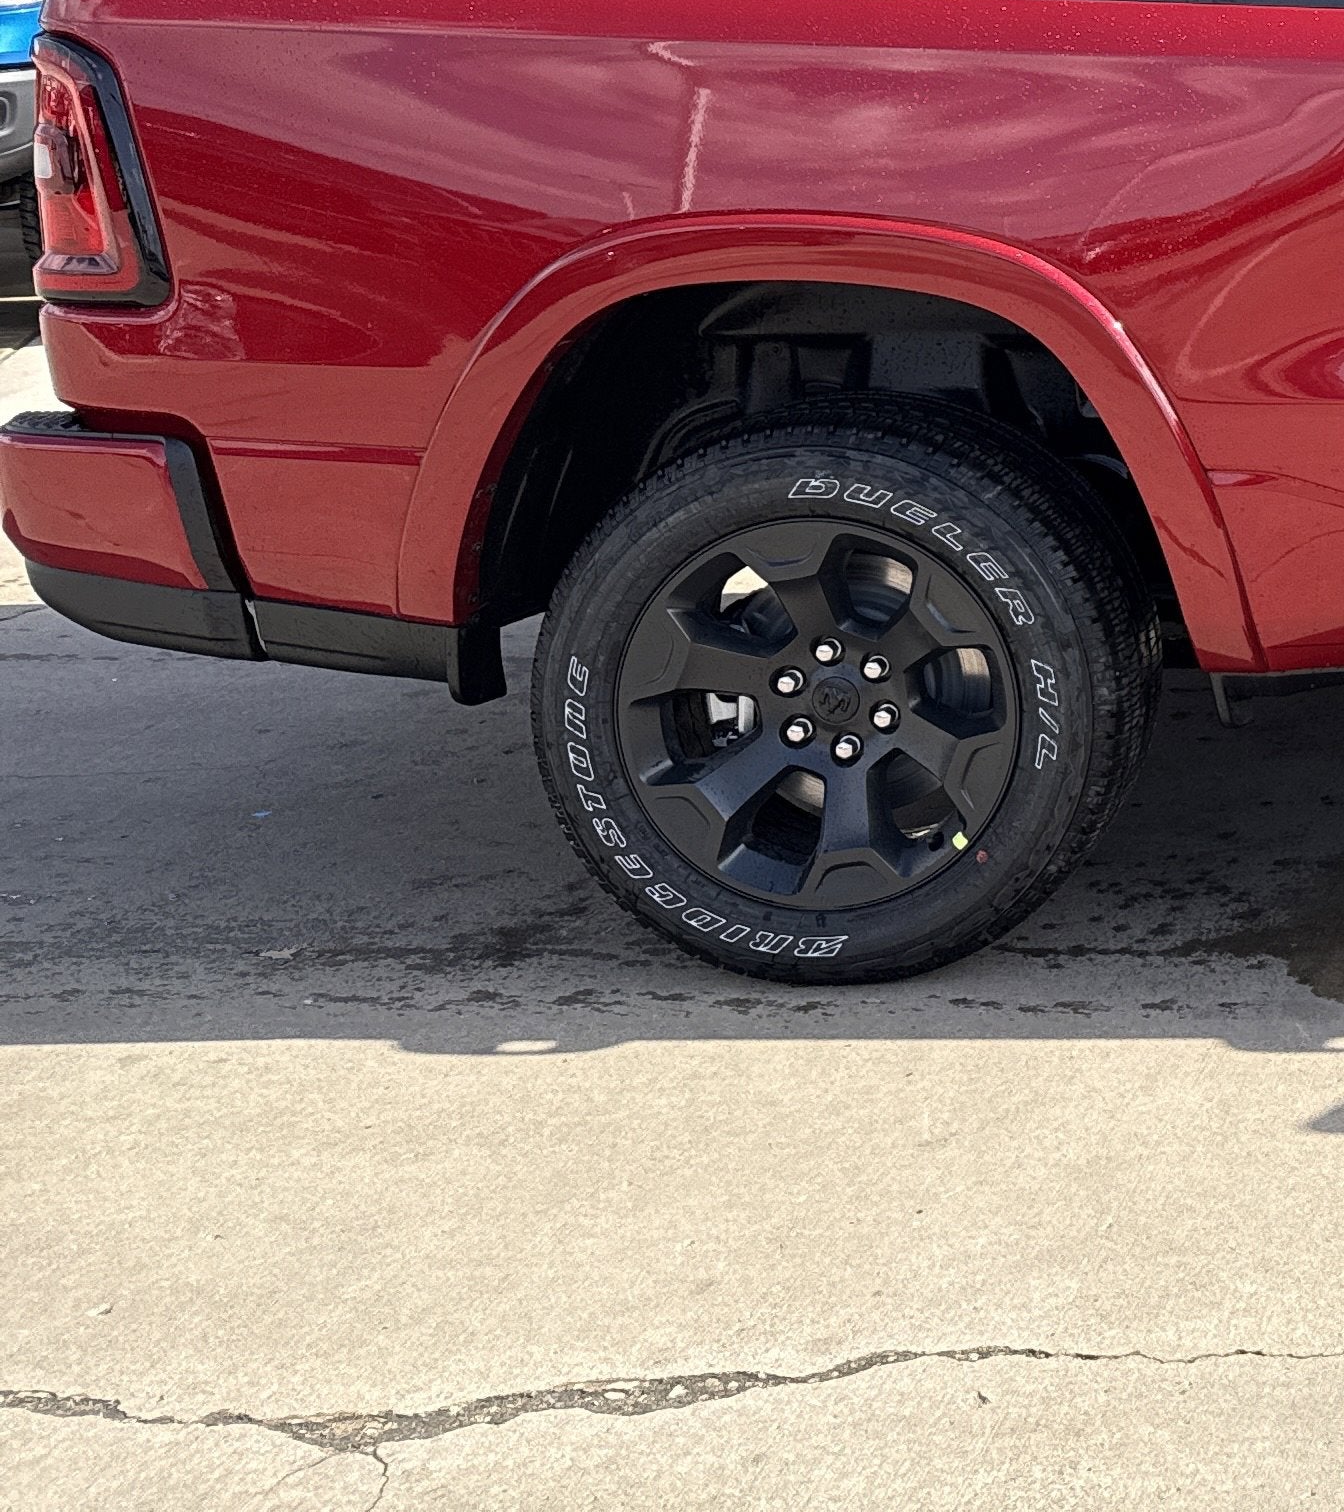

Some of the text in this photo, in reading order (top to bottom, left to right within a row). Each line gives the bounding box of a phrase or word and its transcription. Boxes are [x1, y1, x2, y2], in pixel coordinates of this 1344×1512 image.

[788, 477, 1062, 770] DUELER H/L
[563, 655, 849, 958] BRIDGESTONE
